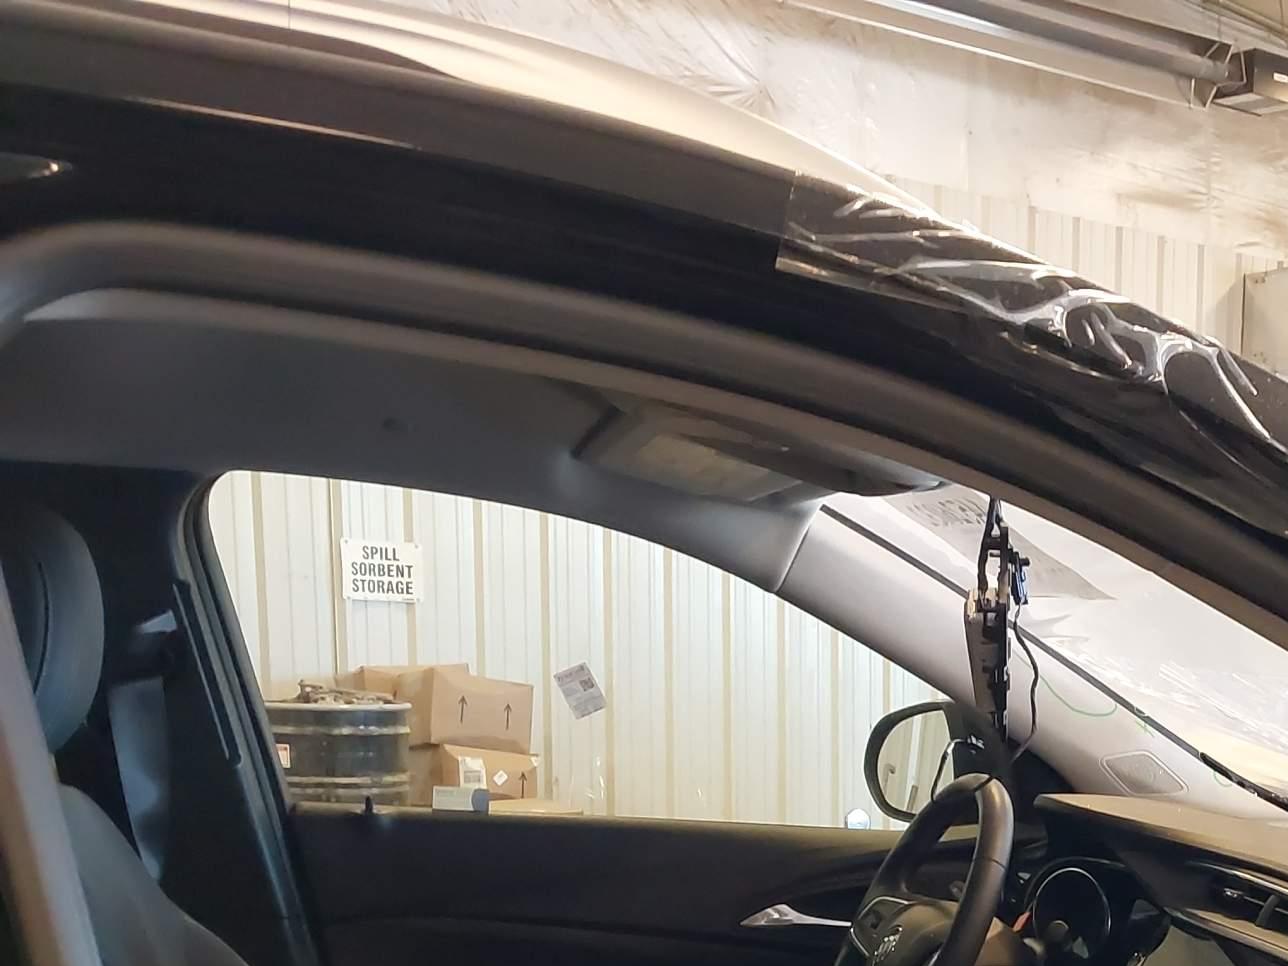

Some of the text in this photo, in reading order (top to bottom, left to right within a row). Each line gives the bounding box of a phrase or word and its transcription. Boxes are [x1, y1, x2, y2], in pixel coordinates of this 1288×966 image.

[362, 545, 400, 561] SPILL
[351, 561, 414, 579] SORBENT
[352, 578, 414, 595] STORAGE
